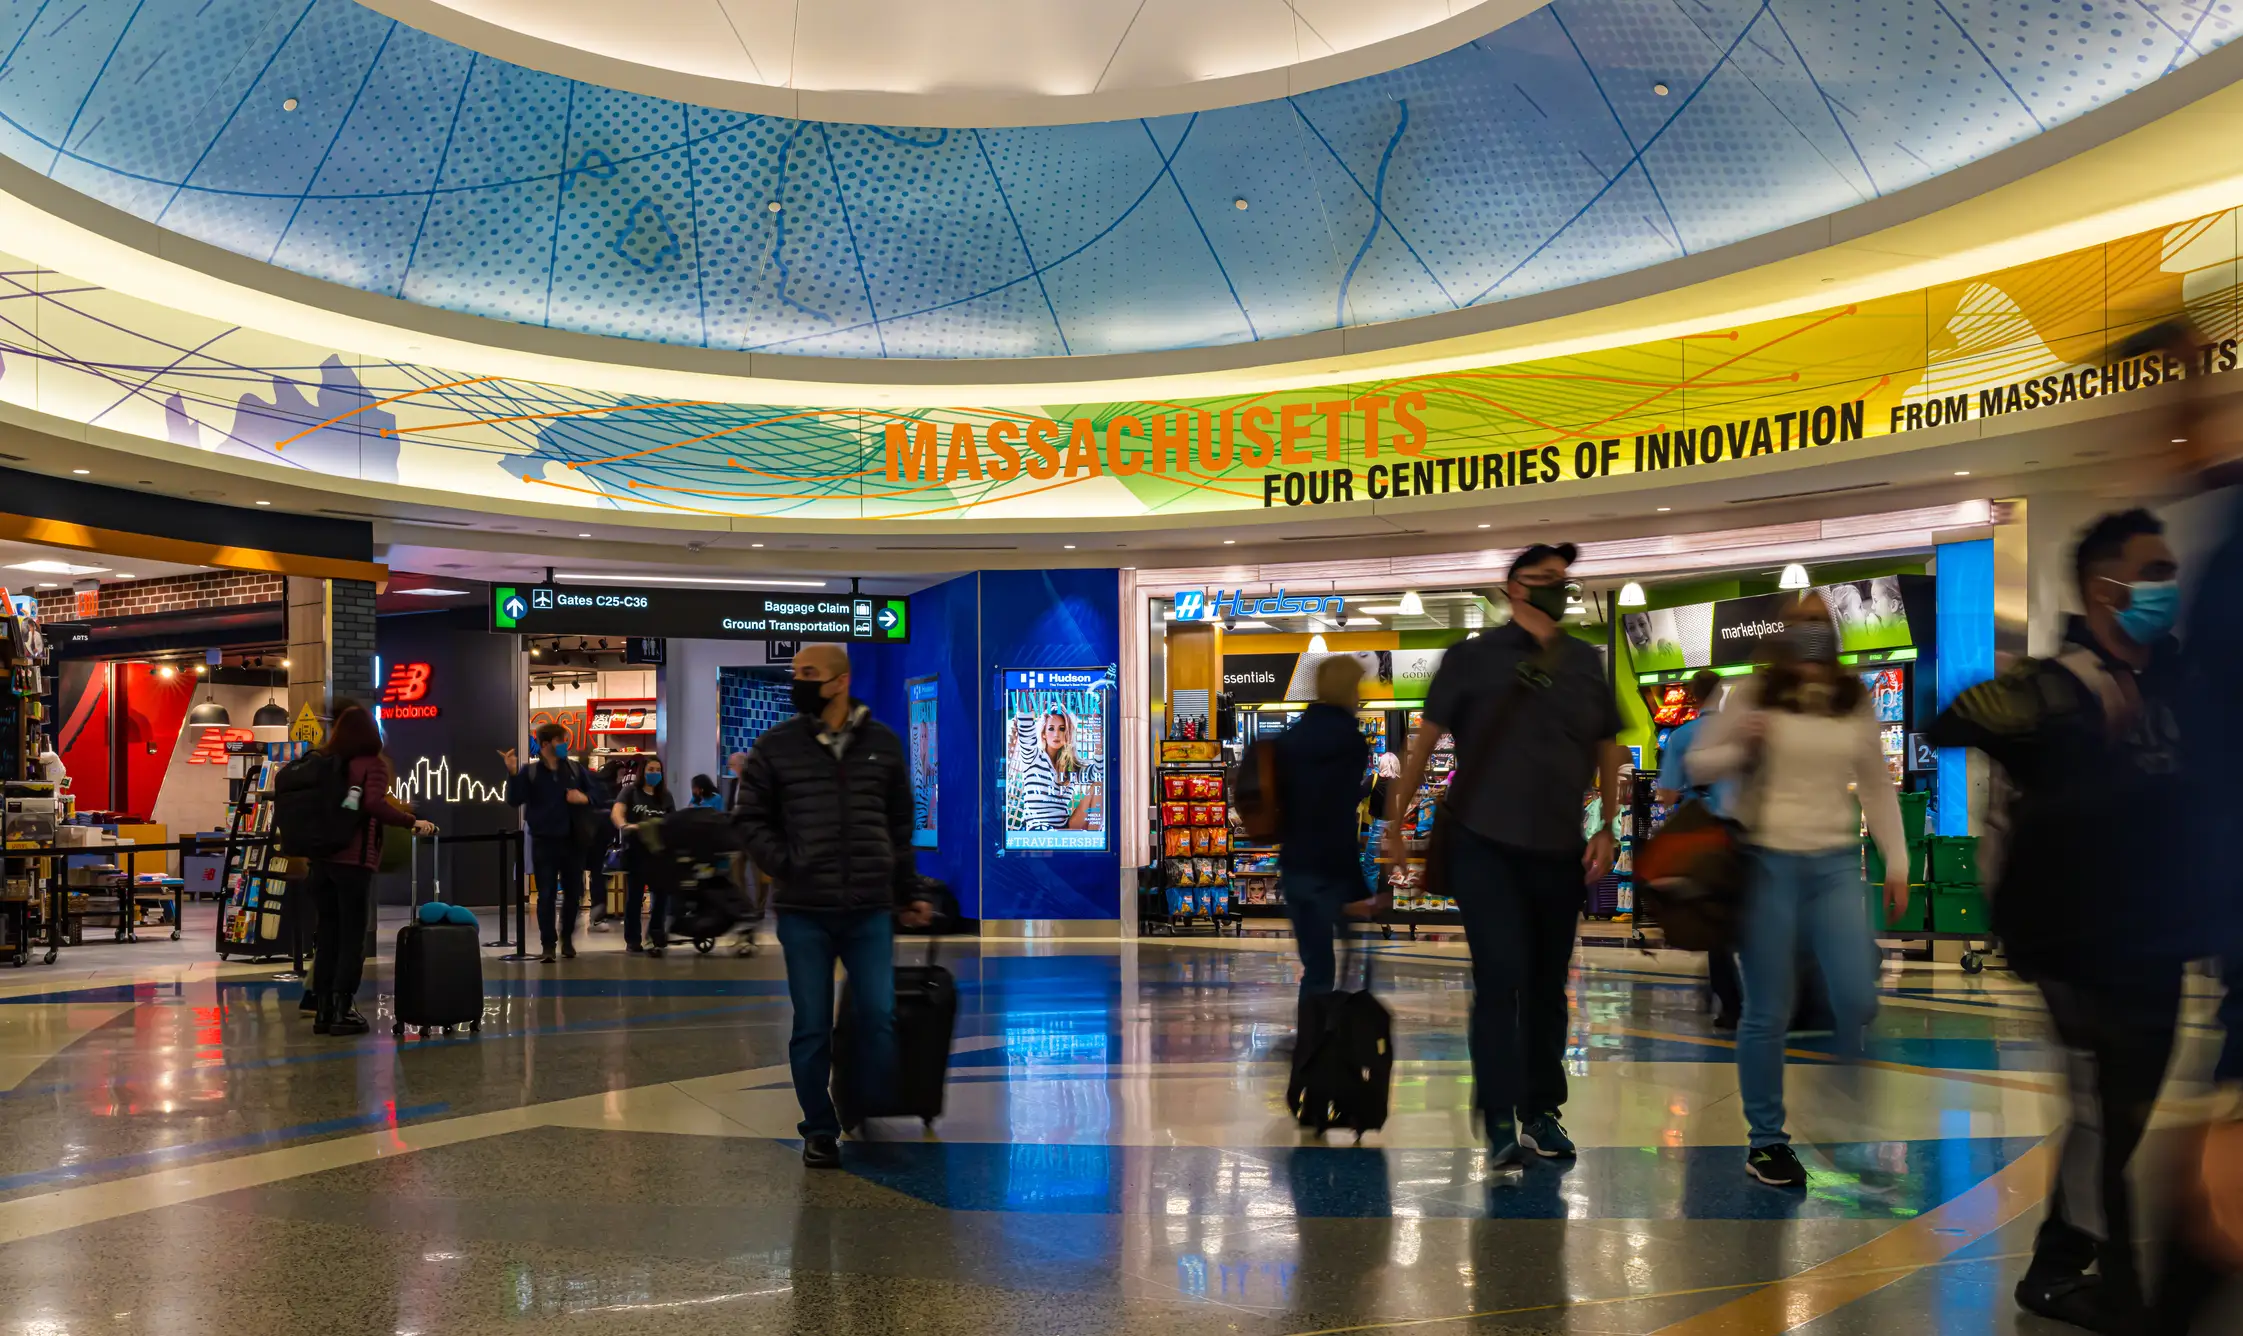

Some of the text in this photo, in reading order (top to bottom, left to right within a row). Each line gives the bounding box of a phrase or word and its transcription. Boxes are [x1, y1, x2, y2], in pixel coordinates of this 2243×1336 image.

[1890, 338, 2238, 434] FROM MASSACHUSETS
[884, 392, 1428, 482] MASSACHUSETTS
[1264, 400, 1865, 508] FOUR CENTURIES OF INNOVATION
[557, 594, 648, 608] Gates C25-C36
[764, 601, 850, 614] Baggage Claim
[1211, 588, 1345, 617] Hudson
[722, 618, 850, 633] Ground Transportation
[1721, 619, 1785, 639] marketplace
[1049, 673, 1091, 683] Hudson
[1223, 670, 1276, 684] ssentials
[1011, 691, 1101, 715] VANITY FAIR
[380, 704, 438, 719] ew balance
[1006, 837, 1105, 848] #TRAVELERSBFF
